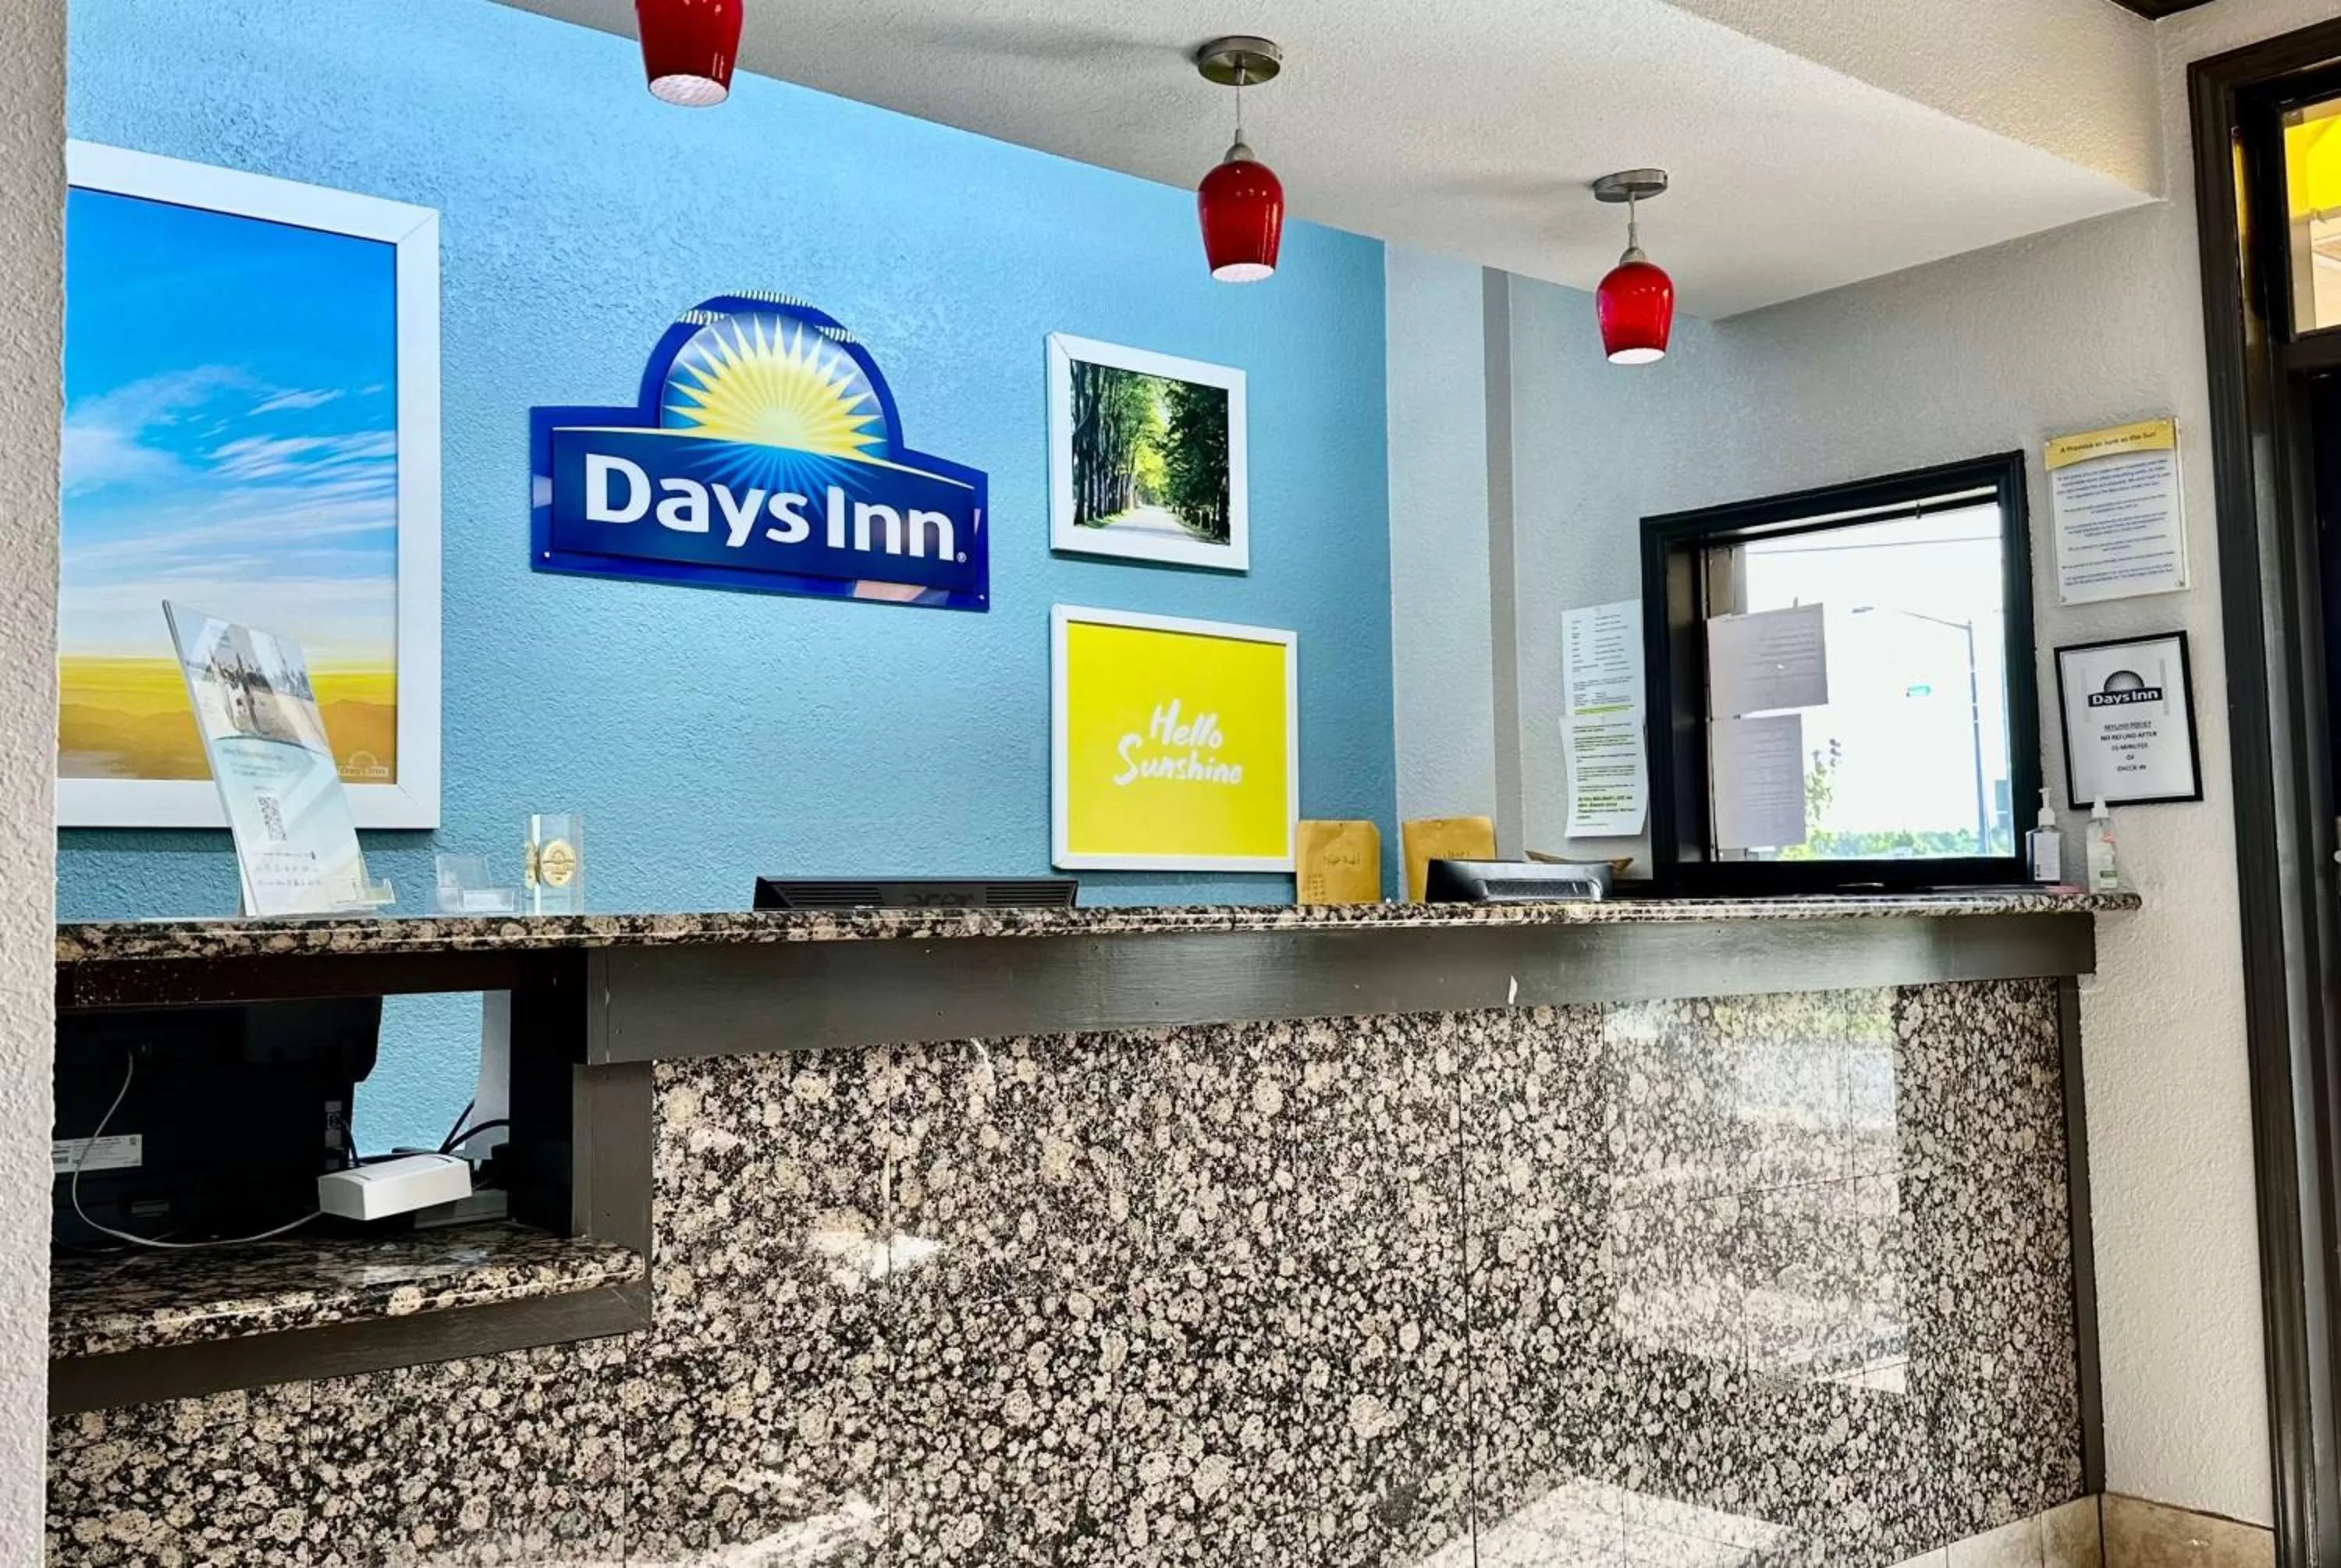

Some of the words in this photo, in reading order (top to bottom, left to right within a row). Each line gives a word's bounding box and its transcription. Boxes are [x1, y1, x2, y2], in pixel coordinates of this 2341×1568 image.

[585, 453, 810, 547] Days
[827, 485, 955, 561] Inn
[1149, 698, 1224, 749] Hello
[2092, 693, 2130, 705] Days
[2132, 690, 2158, 701] Inn
[1112, 733, 1243, 786] Sunshine
